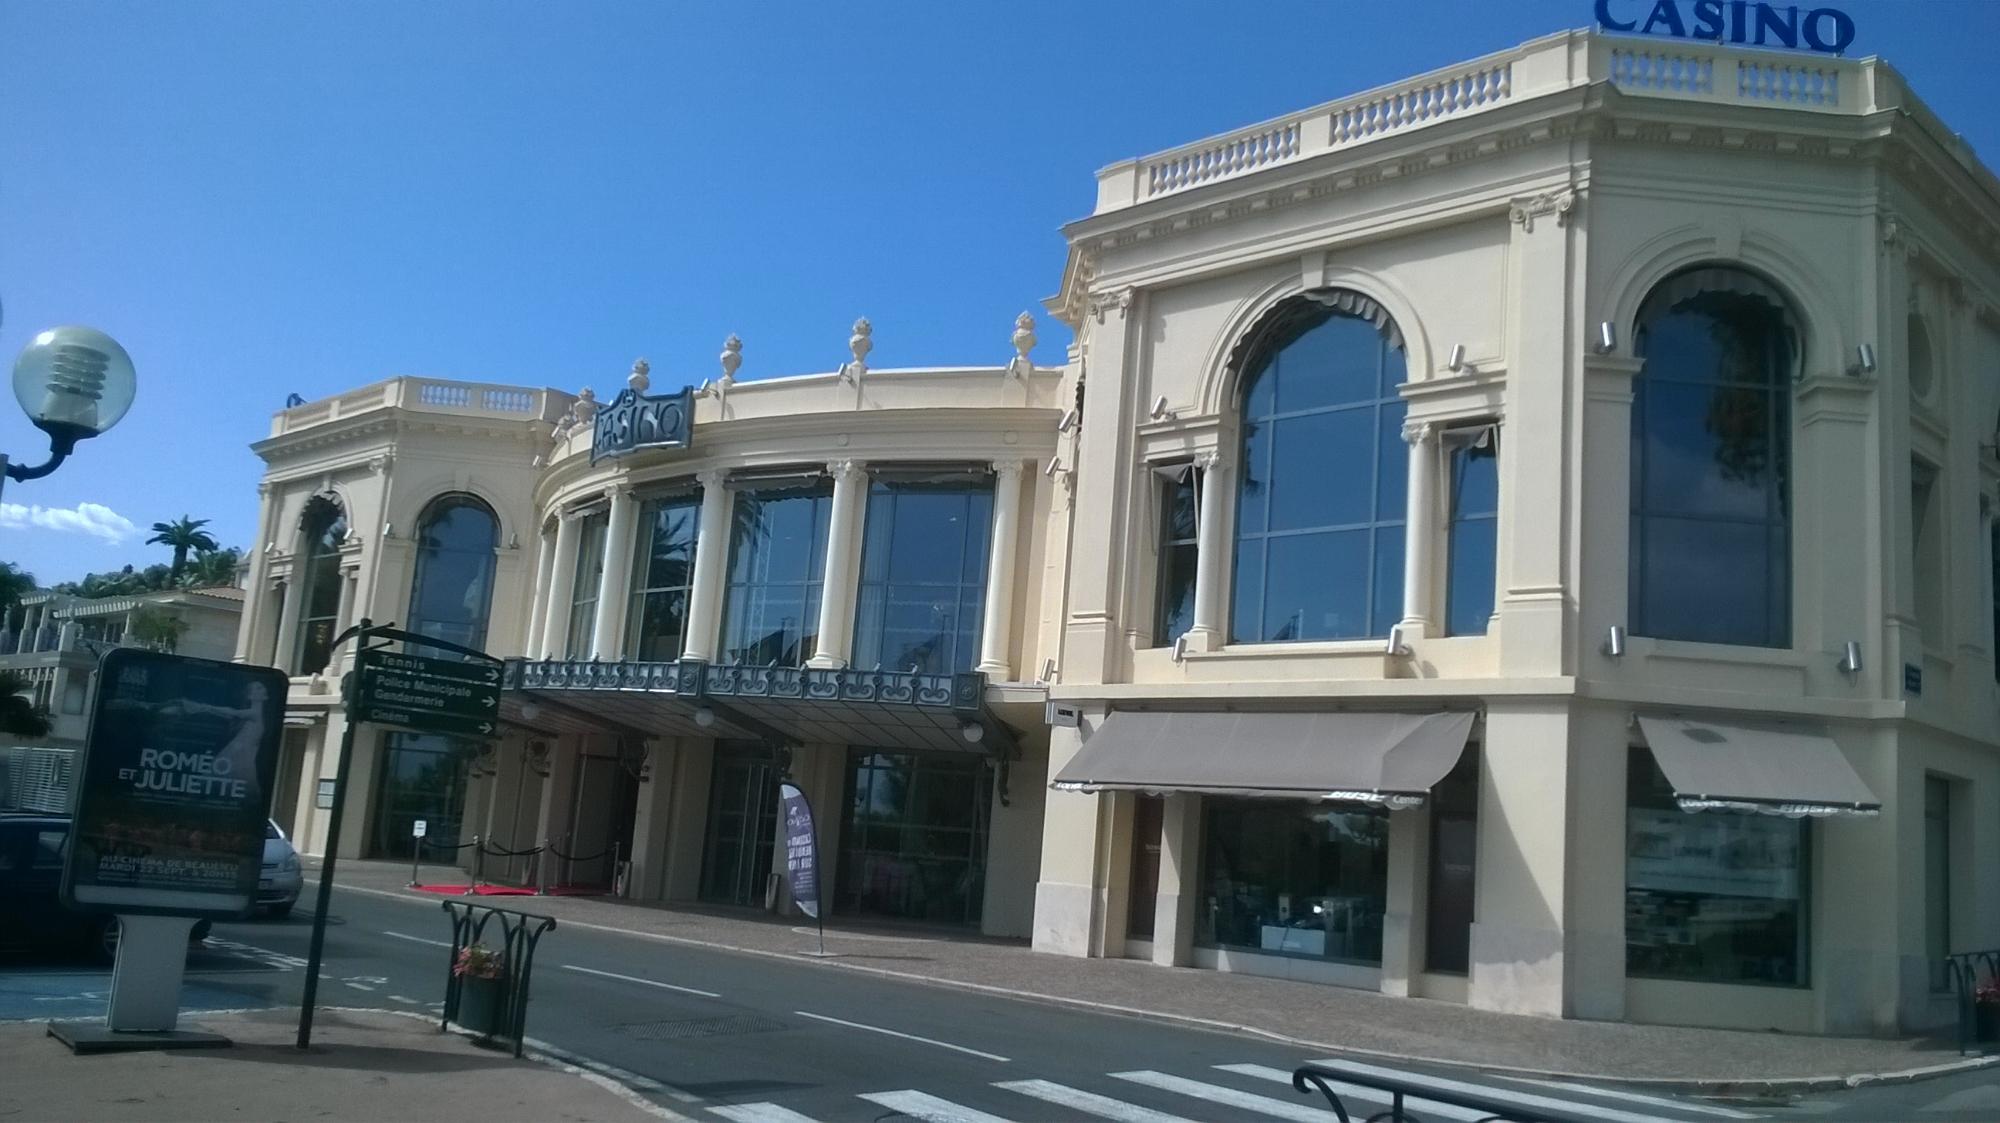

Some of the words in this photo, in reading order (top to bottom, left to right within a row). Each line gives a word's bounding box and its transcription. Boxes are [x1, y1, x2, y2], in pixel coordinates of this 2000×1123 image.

[1594, 0, 1856, 53] CASINO
[380, 654, 425, 670] Tennis
[374, 688, 445, 707] Gendarmerie
[376, 674, 411, 689] Police
[414, 679, 472, 697] Municipale
[140, 748, 232, 775] ROMÉO
[118, 768, 138, 780] ET
[134, 770, 248, 798] JULIETTE
